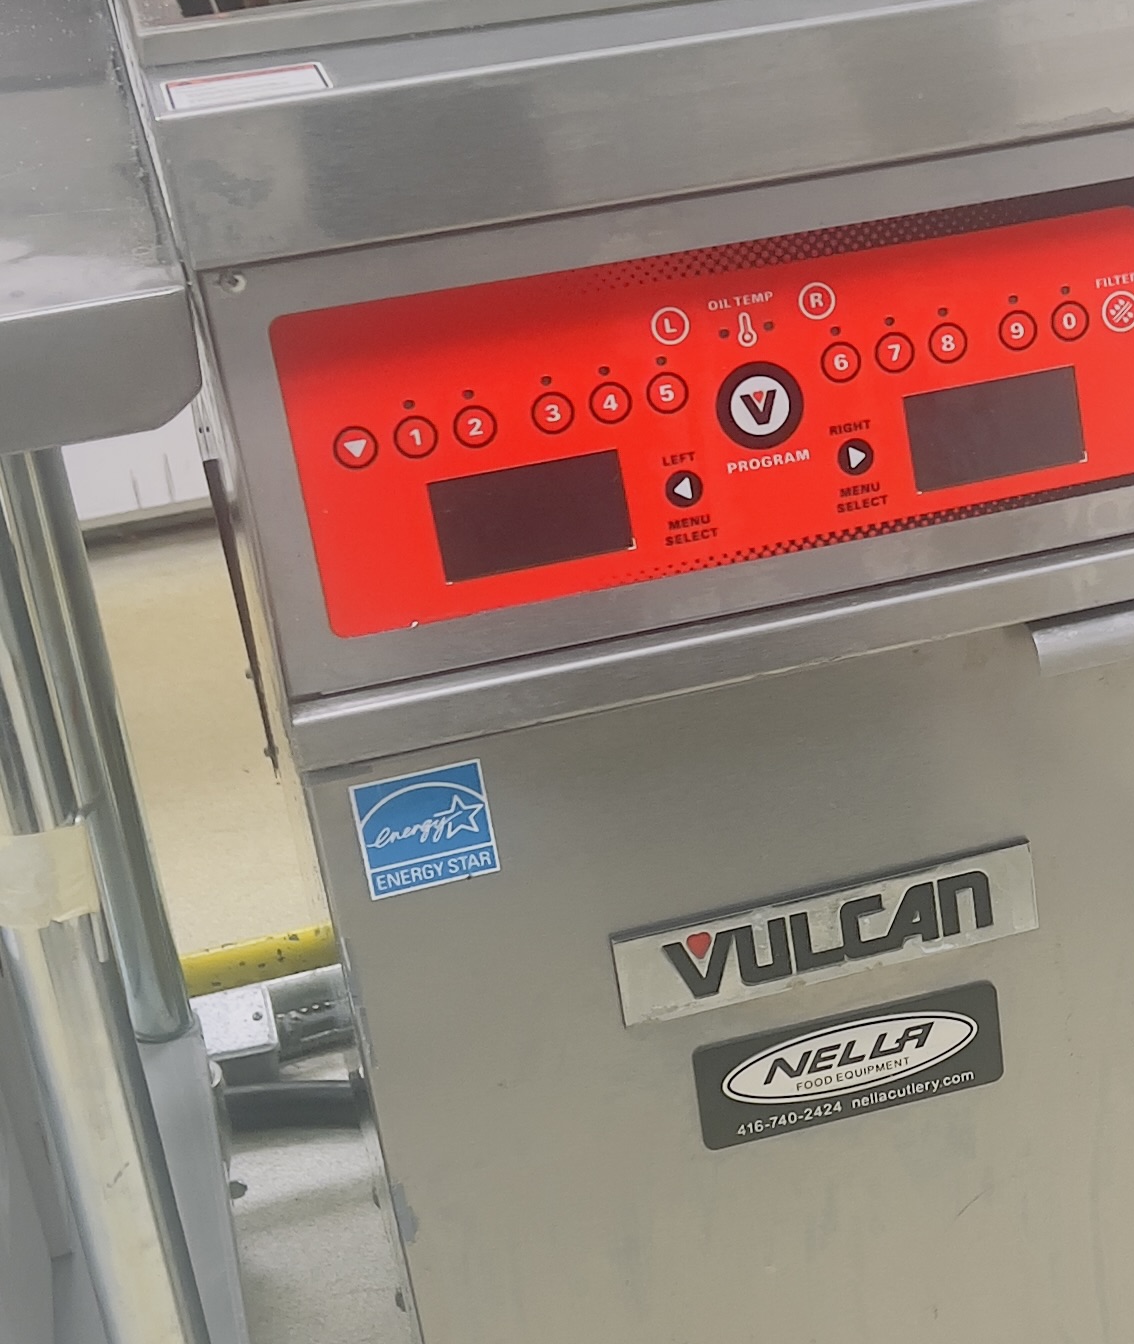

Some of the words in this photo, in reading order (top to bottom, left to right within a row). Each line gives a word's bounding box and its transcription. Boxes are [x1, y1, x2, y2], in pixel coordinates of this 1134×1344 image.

[708, 299, 731, 312] OIL
[733, 291, 774, 307] TEMP
[809, 292, 824, 308] R
[663, 317, 678, 334] L
[1010, 322, 1025, 340] 9
[1062, 312, 1077, 330] 0
[833, 353, 849, 371] 6
[888, 343, 902, 362] 7
[941, 334, 956, 352] 8
[545, 404, 561, 422] 3
[603, 393, 619, 411] 4
[659, 384, 675, 402] 5
[739, 389, 777, 425] V
[409, 428, 423, 446] 1
[467, 417, 484, 437] 2
[829, 419, 872, 436] RIGHT
[662, 451, 696, 467] LEFT
[727, 448, 811, 474] PROGRAM
[840, 481, 881, 498] MENU
[837, 494, 888, 514] SELECT
[668, 513, 711, 531] MENU
[665, 526, 719, 547] SELECT
[367, 811, 460, 849] energy
[376, 861, 444, 891] ENERGY
[447, 851, 492, 874] STAR
[661, 869, 994, 1000] VULCAN
[763, 1021, 935, 1086] NELLA
[796, 1074, 833, 1092] FOOD
[836, 1056, 911, 1083] EQUIPMENT
[736, 1100, 843, 1136] 416-740-2424
[851, 1069, 976, 1109] nellacutlery.com
